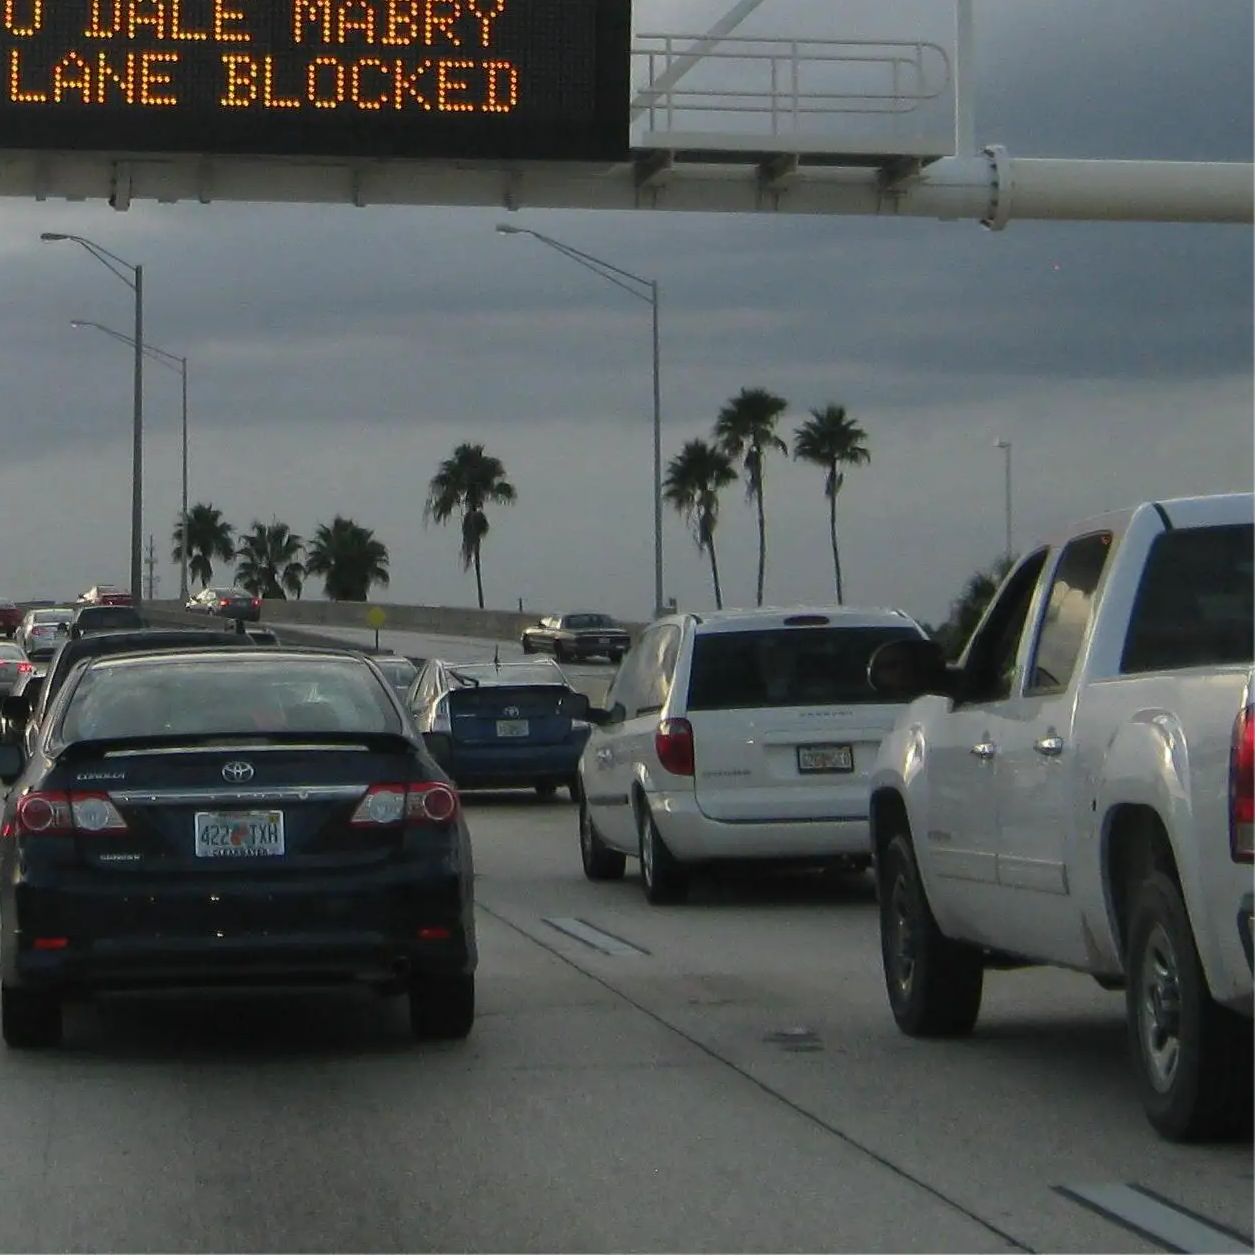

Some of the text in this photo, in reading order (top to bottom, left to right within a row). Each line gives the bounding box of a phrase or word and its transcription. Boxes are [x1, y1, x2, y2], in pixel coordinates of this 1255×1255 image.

[10, 48, 180, 106] LANE
[221, 53, 519, 113] BLOCKED
[200, 824, 229, 846] 422
